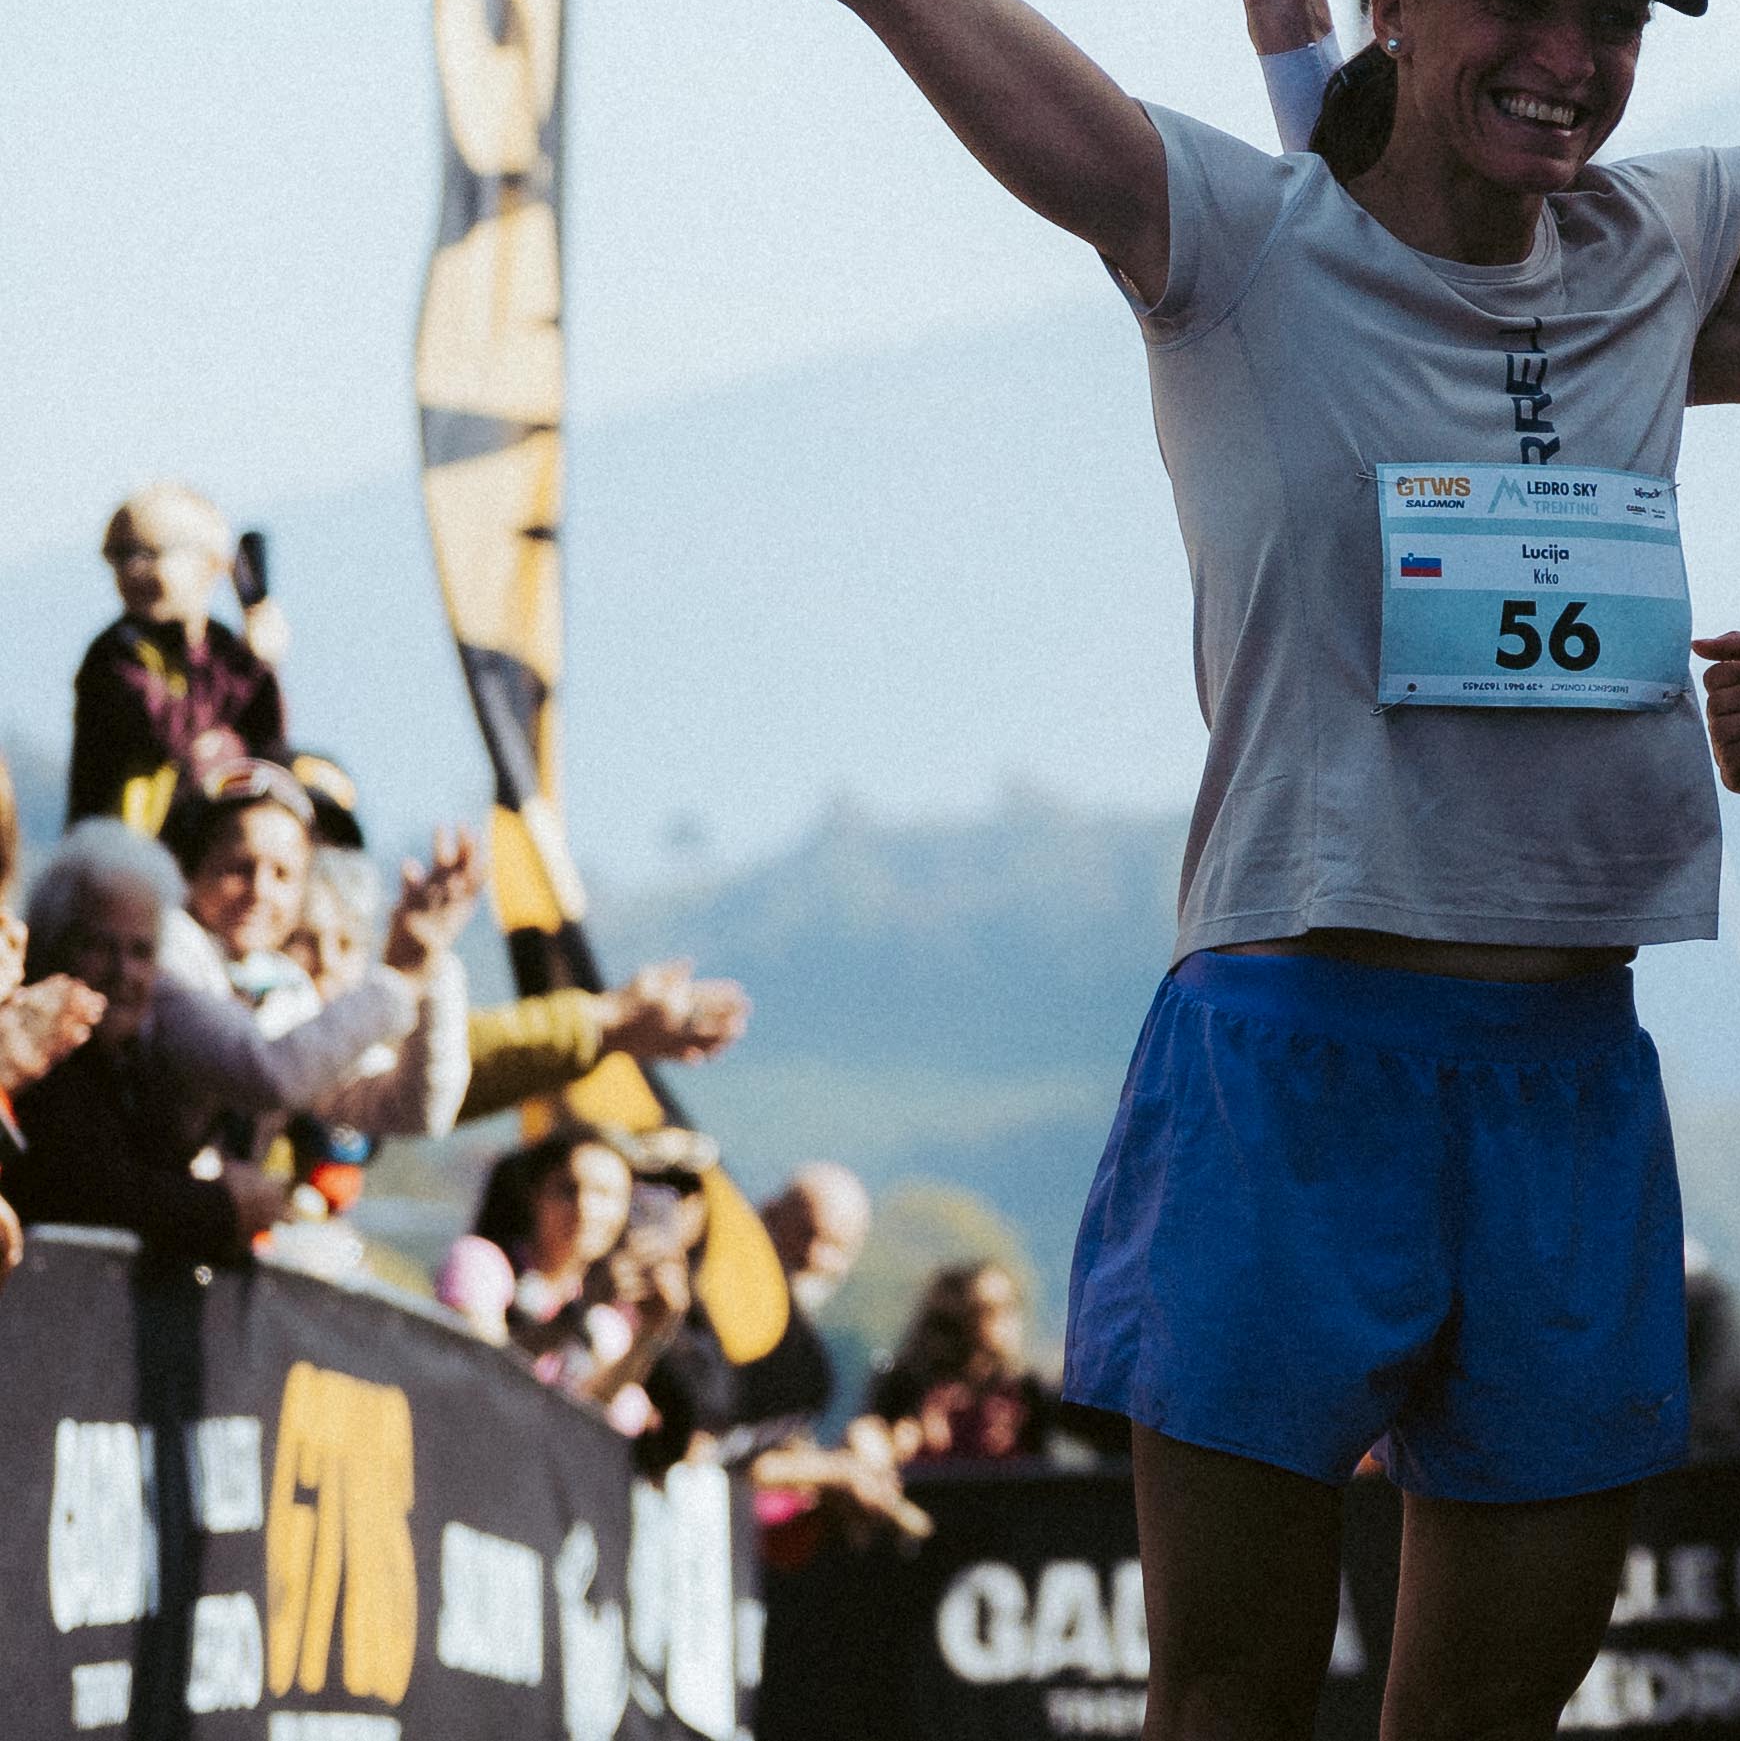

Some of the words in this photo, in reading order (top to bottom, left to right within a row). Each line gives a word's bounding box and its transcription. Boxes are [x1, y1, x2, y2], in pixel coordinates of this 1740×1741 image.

[1396, 476, 1471, 497] GTWS
[1527, 480, 1570, 497] LEDRO
[1573, 481, 1598, 498] SKY
[1405, 498, 1466, 509] SALOMON
[1532, 499, 1599, 517] TRENTINO
[1521, 543, 1570, 565] Lucija
[1533, 568, 1560, 586] Krko
[1494, 598, 1602, 672] 56
